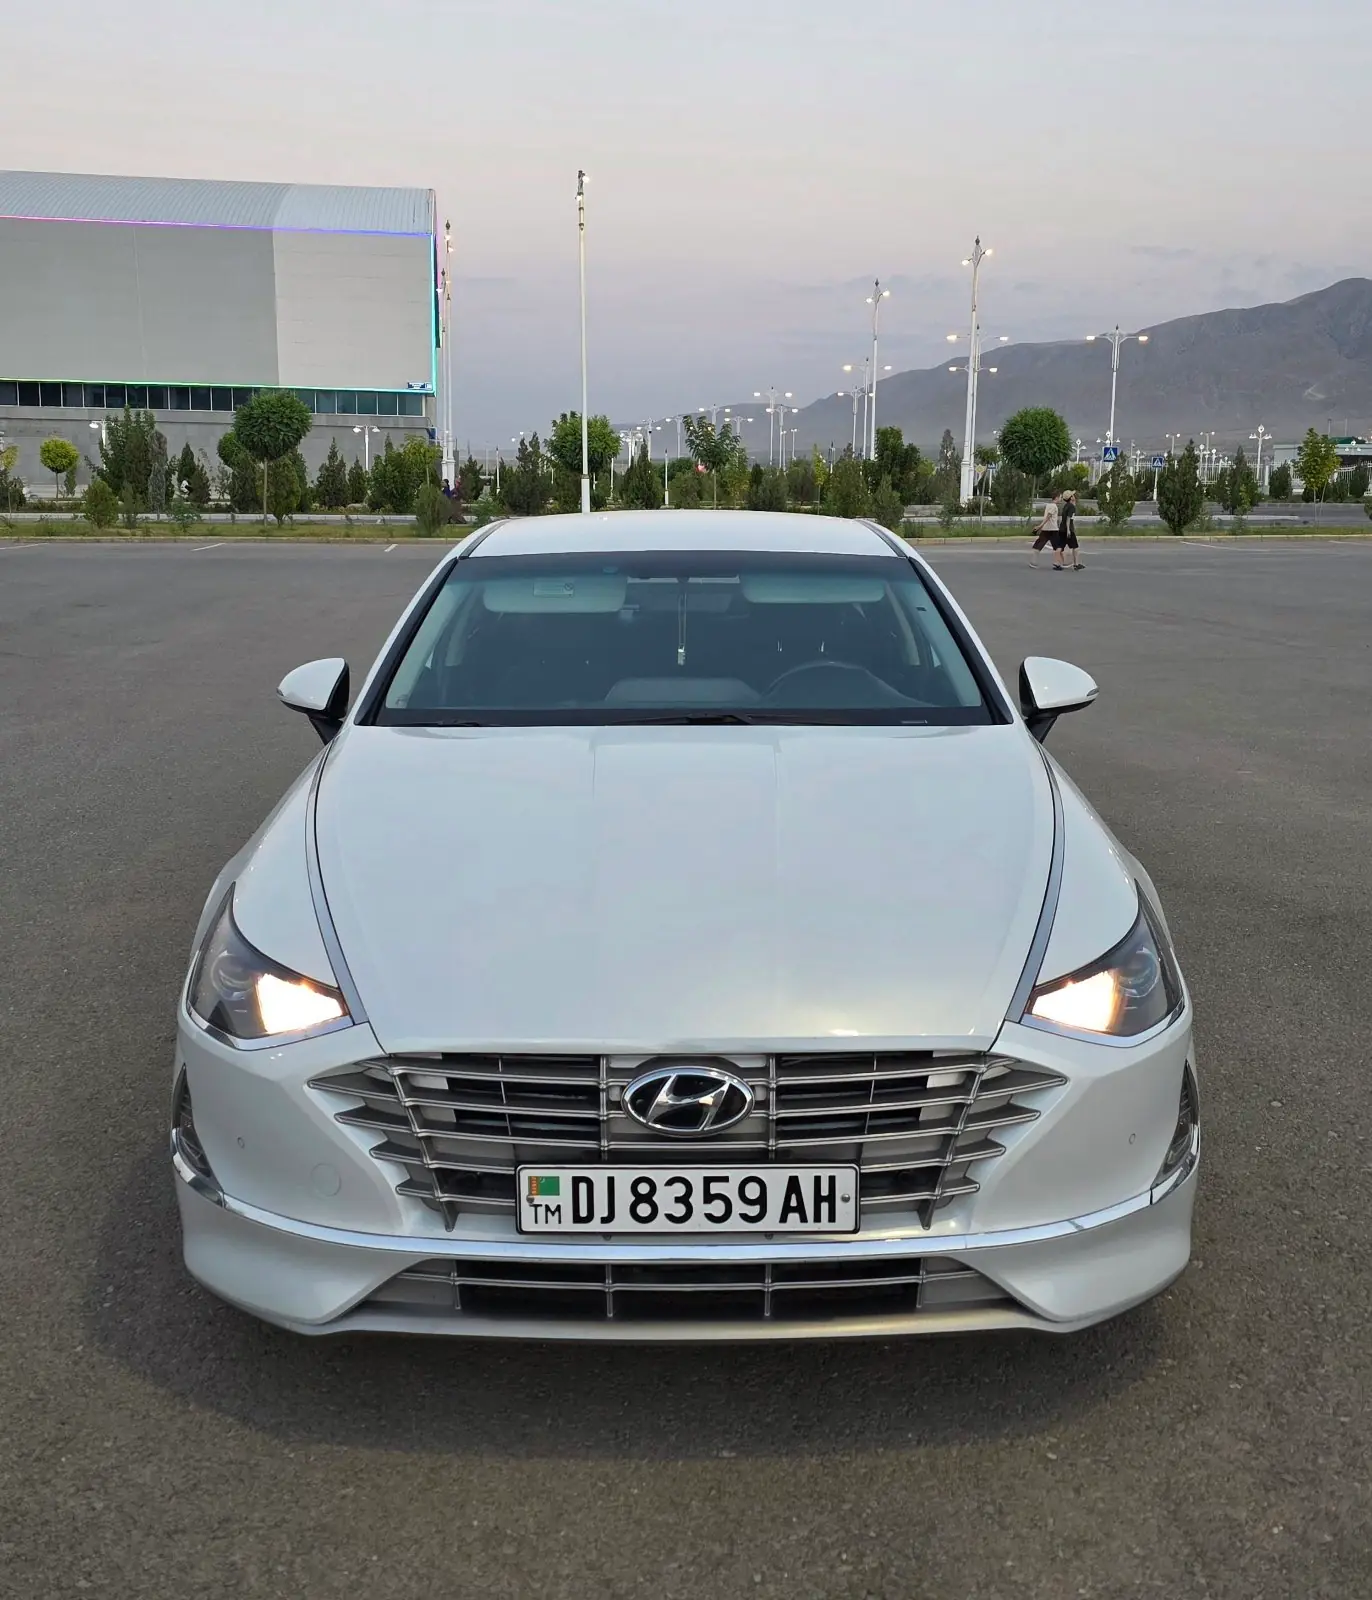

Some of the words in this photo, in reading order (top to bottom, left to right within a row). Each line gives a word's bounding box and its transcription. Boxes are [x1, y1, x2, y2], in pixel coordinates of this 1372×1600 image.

[532, 1204, 561, 1224] TM
[572, 1176, 615, 1224] DJ
[629, 1175, 767, 1224] 8359
[779, 1175, 836, 1223] AH
